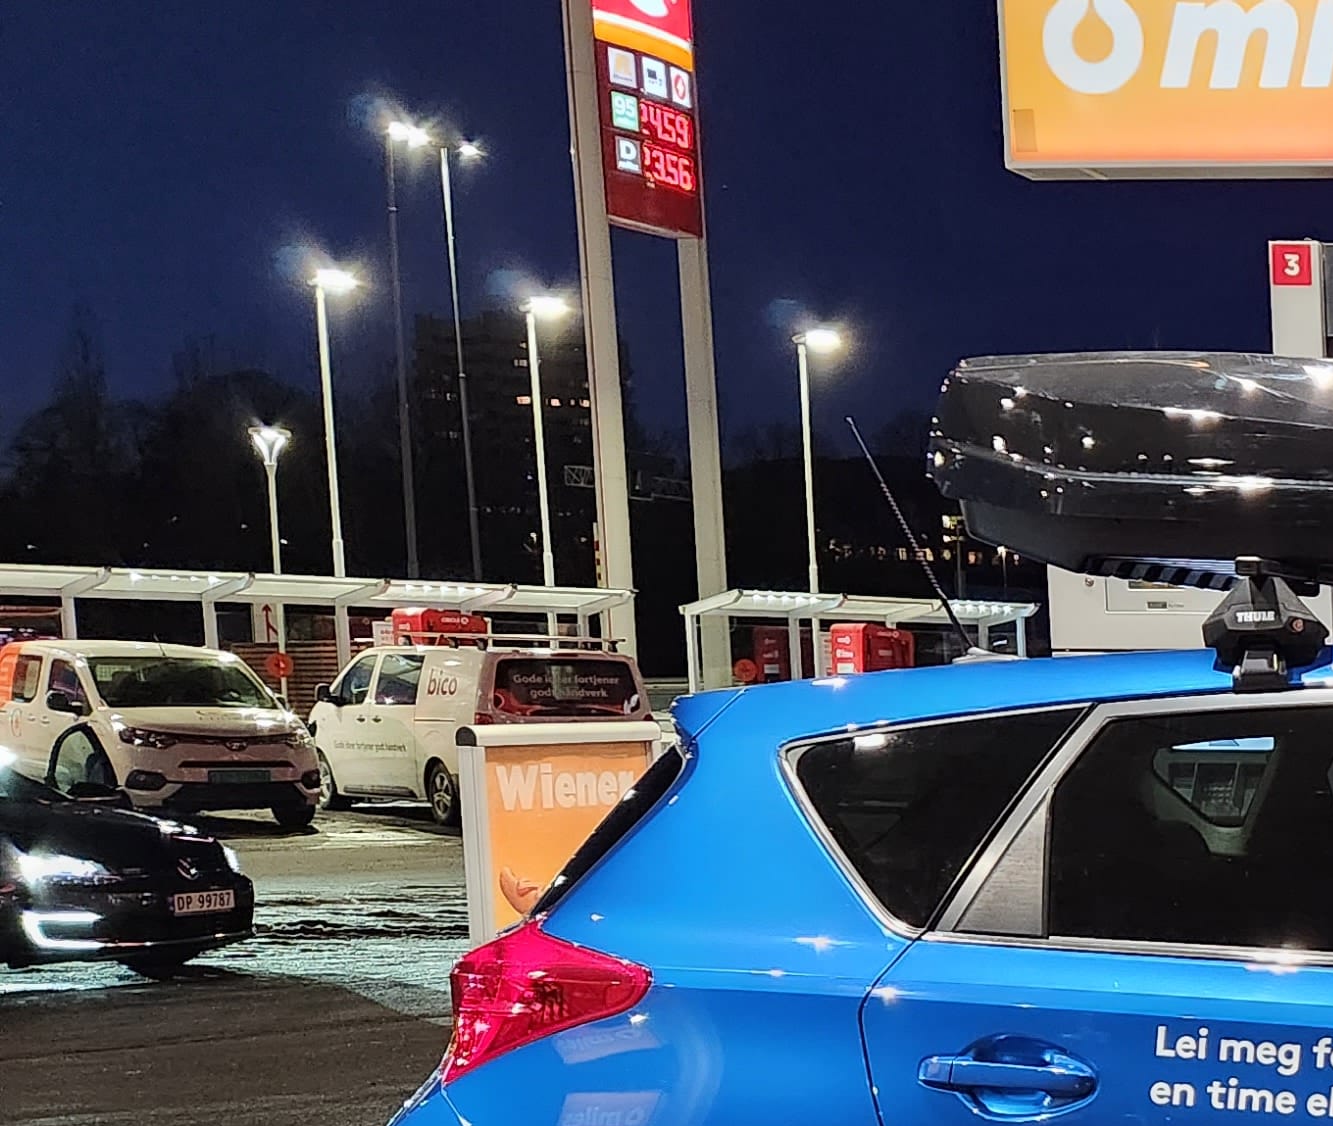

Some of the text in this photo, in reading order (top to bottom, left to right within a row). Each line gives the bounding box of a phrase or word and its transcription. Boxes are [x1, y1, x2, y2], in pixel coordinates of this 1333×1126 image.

[1283, 253, 1300, 276] 3
[1235, 610, 1276, 623] THULE
[427, 668, 458, 696] bico
[495, 763, 635, 811] Wiener
[177, 892, 232, 911] DP 99787
[1155, 1025, 1209, 1060] Lei
[1218, 1037, 1302, 1077] meg
[1149, 1080, 1196, 1107] en
[1206, 1077, 1297, 1115] time
